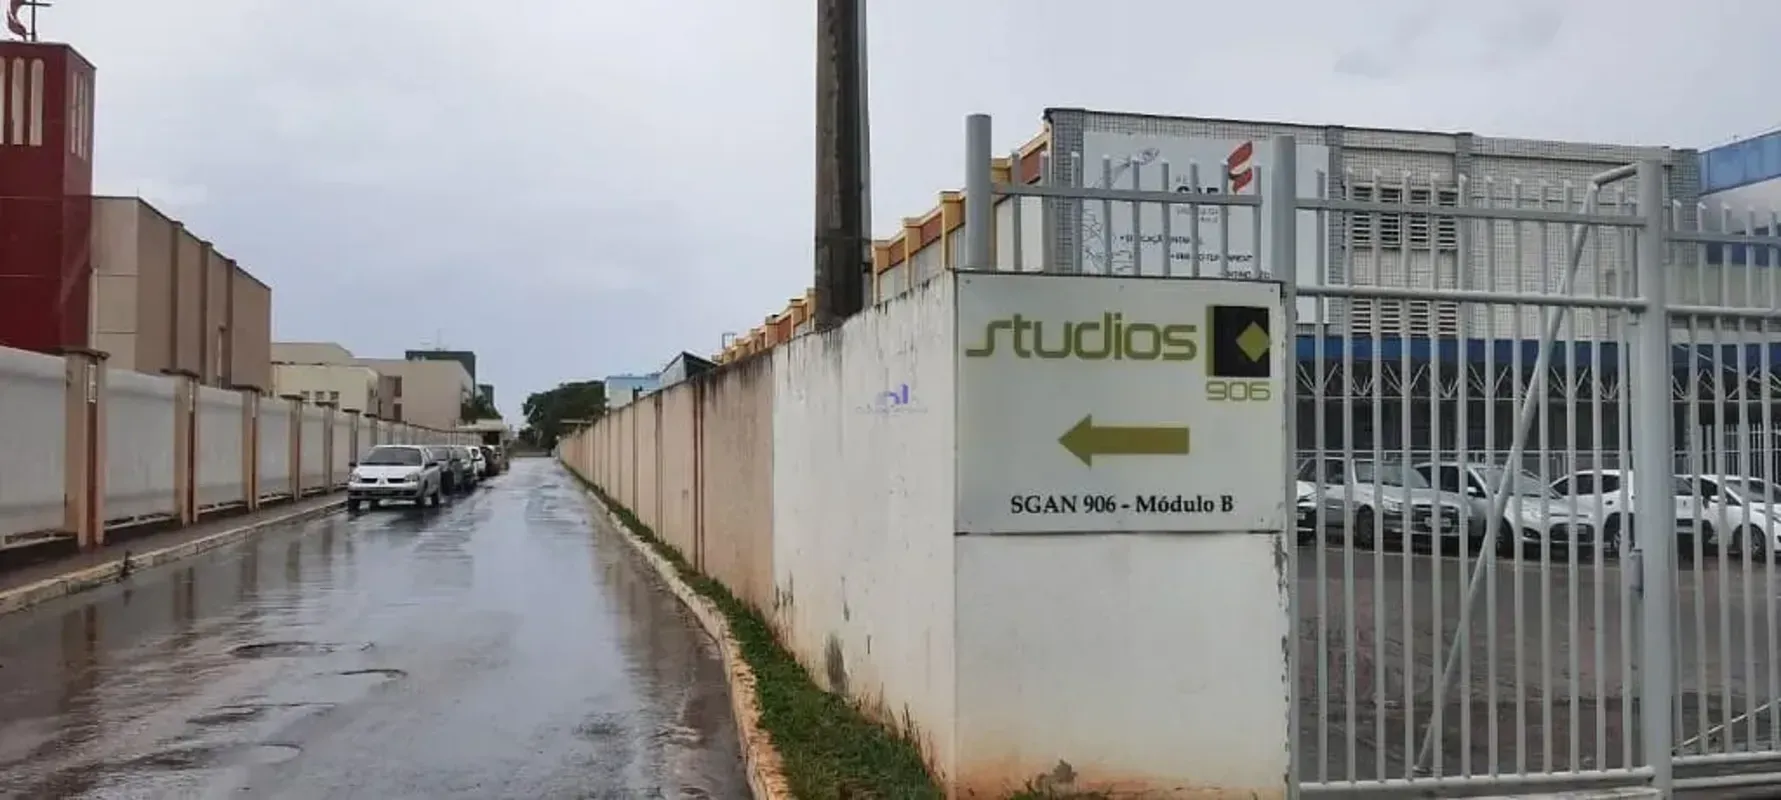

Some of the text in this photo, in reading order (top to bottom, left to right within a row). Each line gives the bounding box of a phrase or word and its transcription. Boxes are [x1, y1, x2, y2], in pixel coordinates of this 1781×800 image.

[965, 311, 1197, 361] studios
[1206, 381, 1271, 401] 906
[1010, 494, 1078, 514] SGAN
[1083, 494, 1117, 514] 906
[1135, 494, 1215, 514] Módulo
[1220, 494, 1234, 513] B
